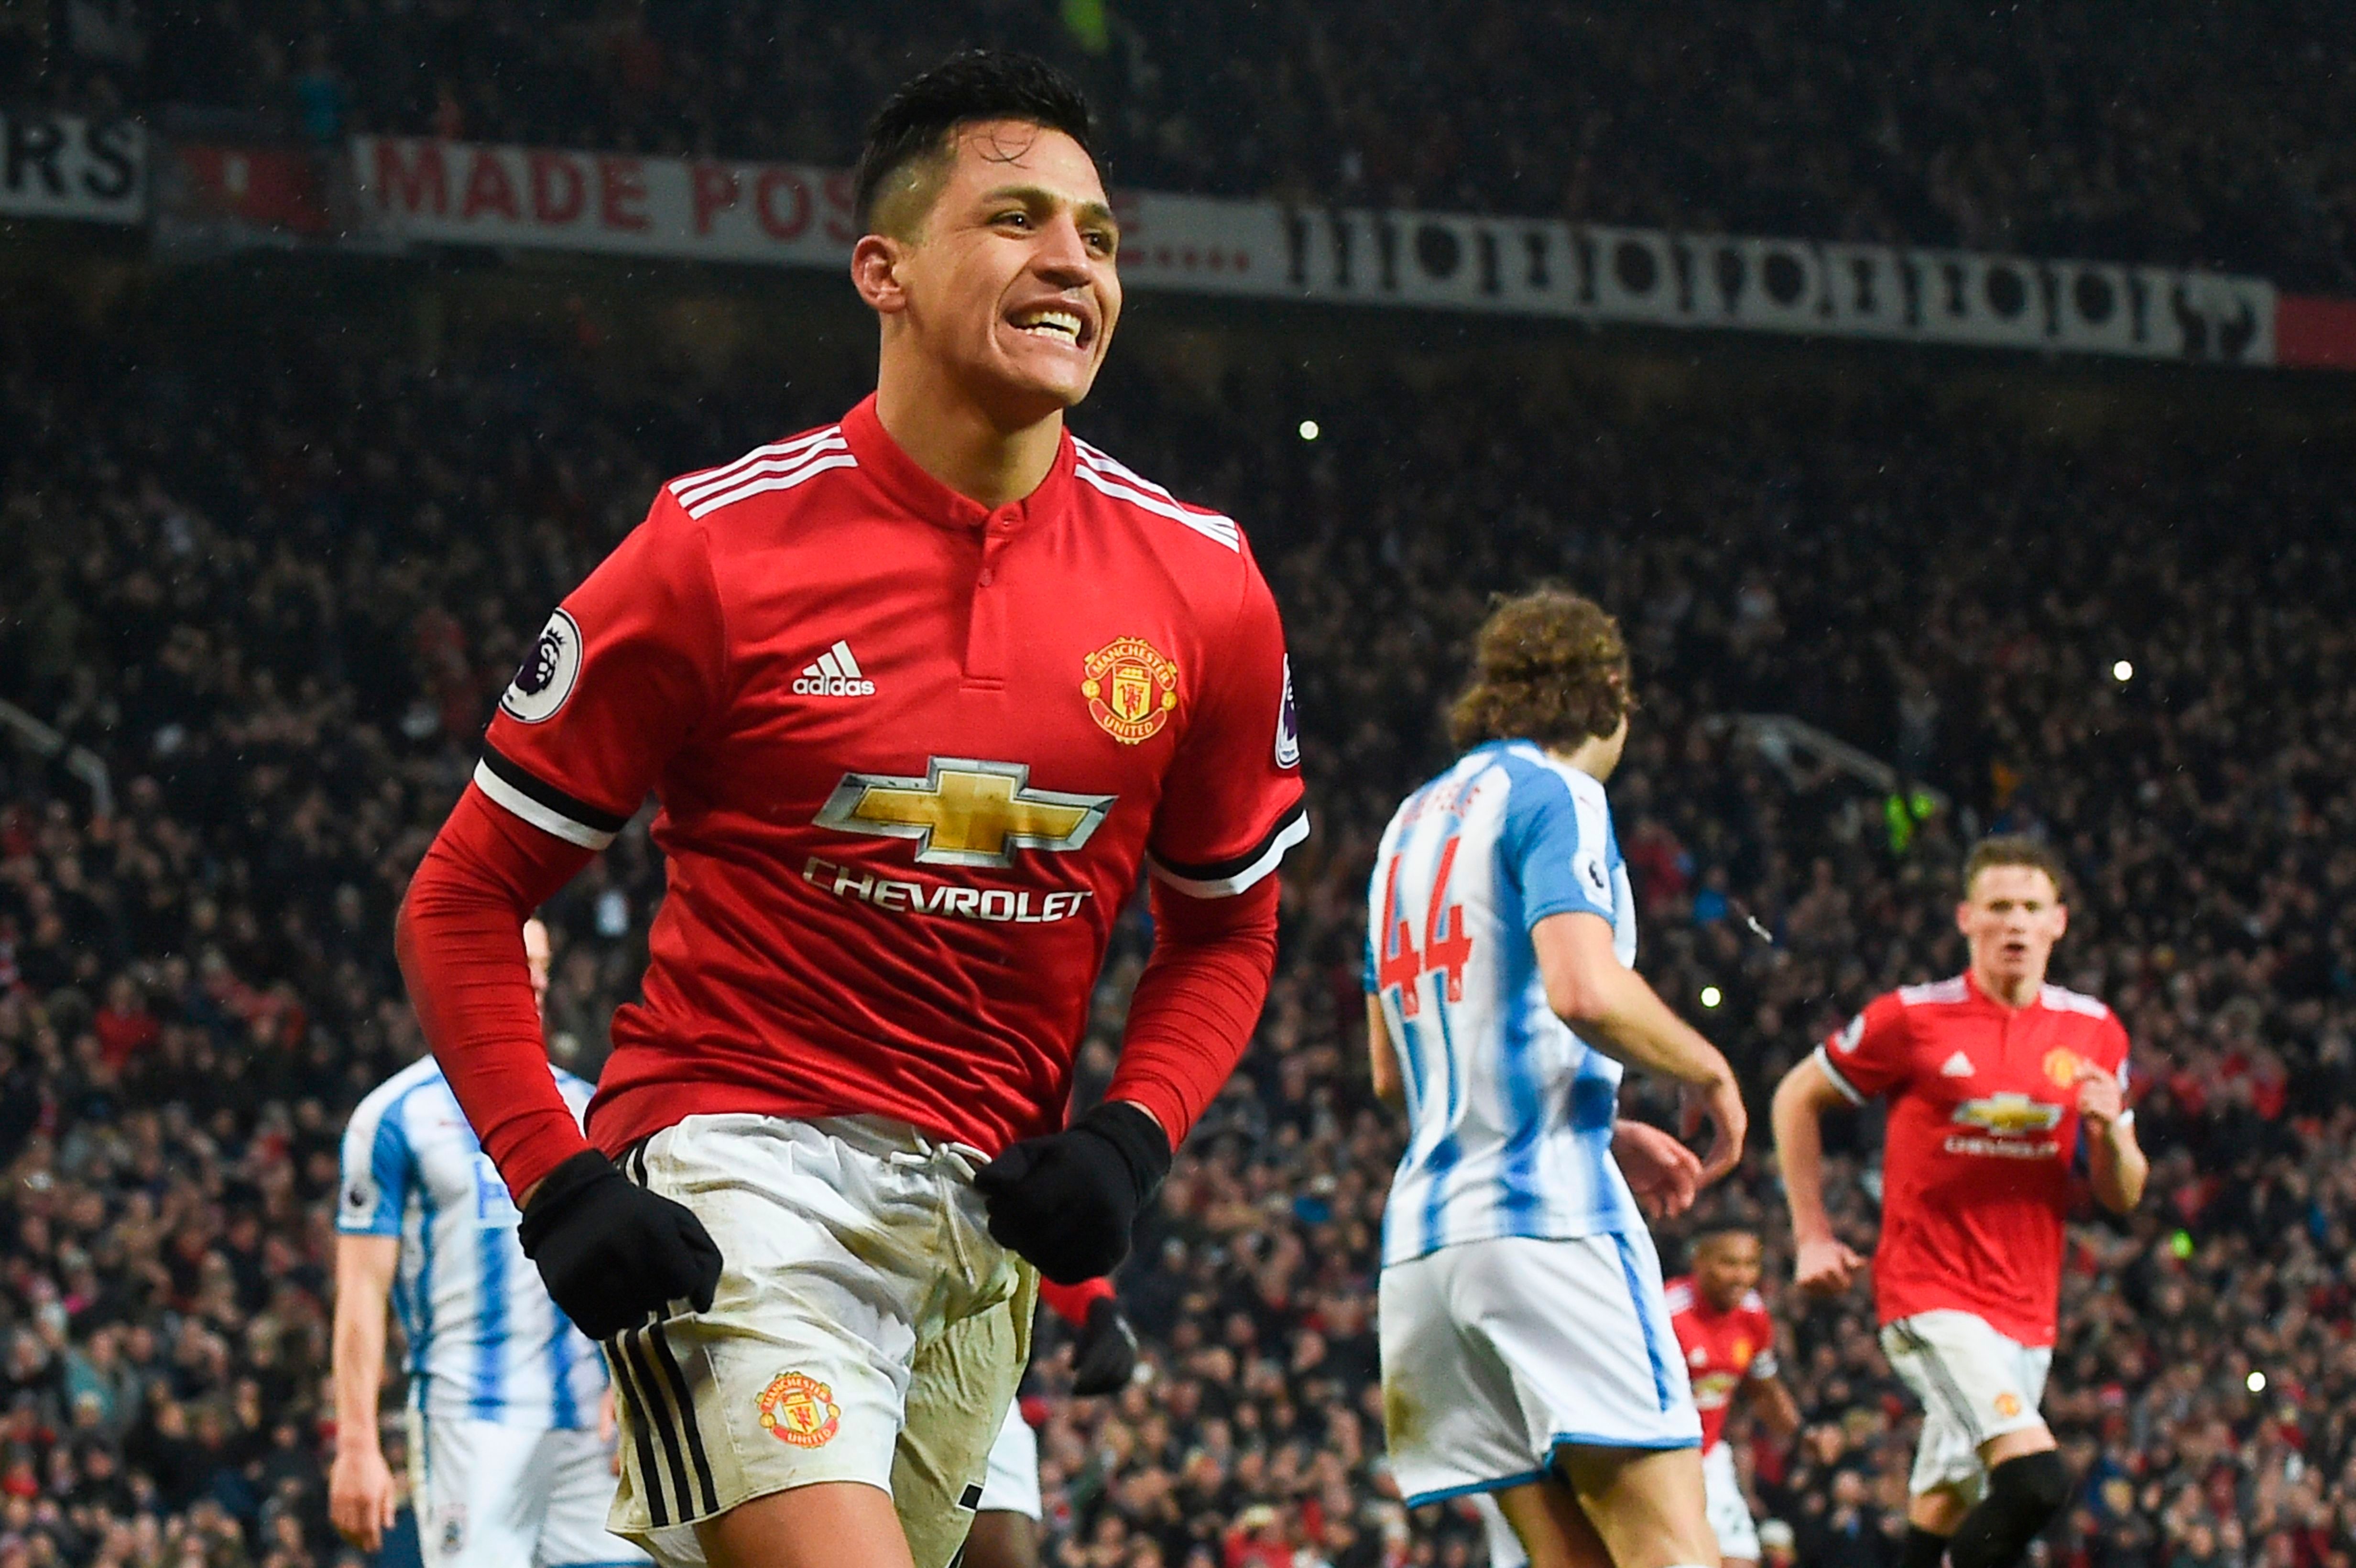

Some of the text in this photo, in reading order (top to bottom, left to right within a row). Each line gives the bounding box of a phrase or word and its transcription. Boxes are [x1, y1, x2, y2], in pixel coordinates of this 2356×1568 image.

[374, 138, 653, 232] MADE
[792, 675, 876, 697] adidas
[1091, 644, 1170, 684] MANCHESTER
[1103, 715, 1154, 737] UNITED
[803, 856, 1093, 923] CHEVROLET
[1379, 837, 1473, 1016] 44
